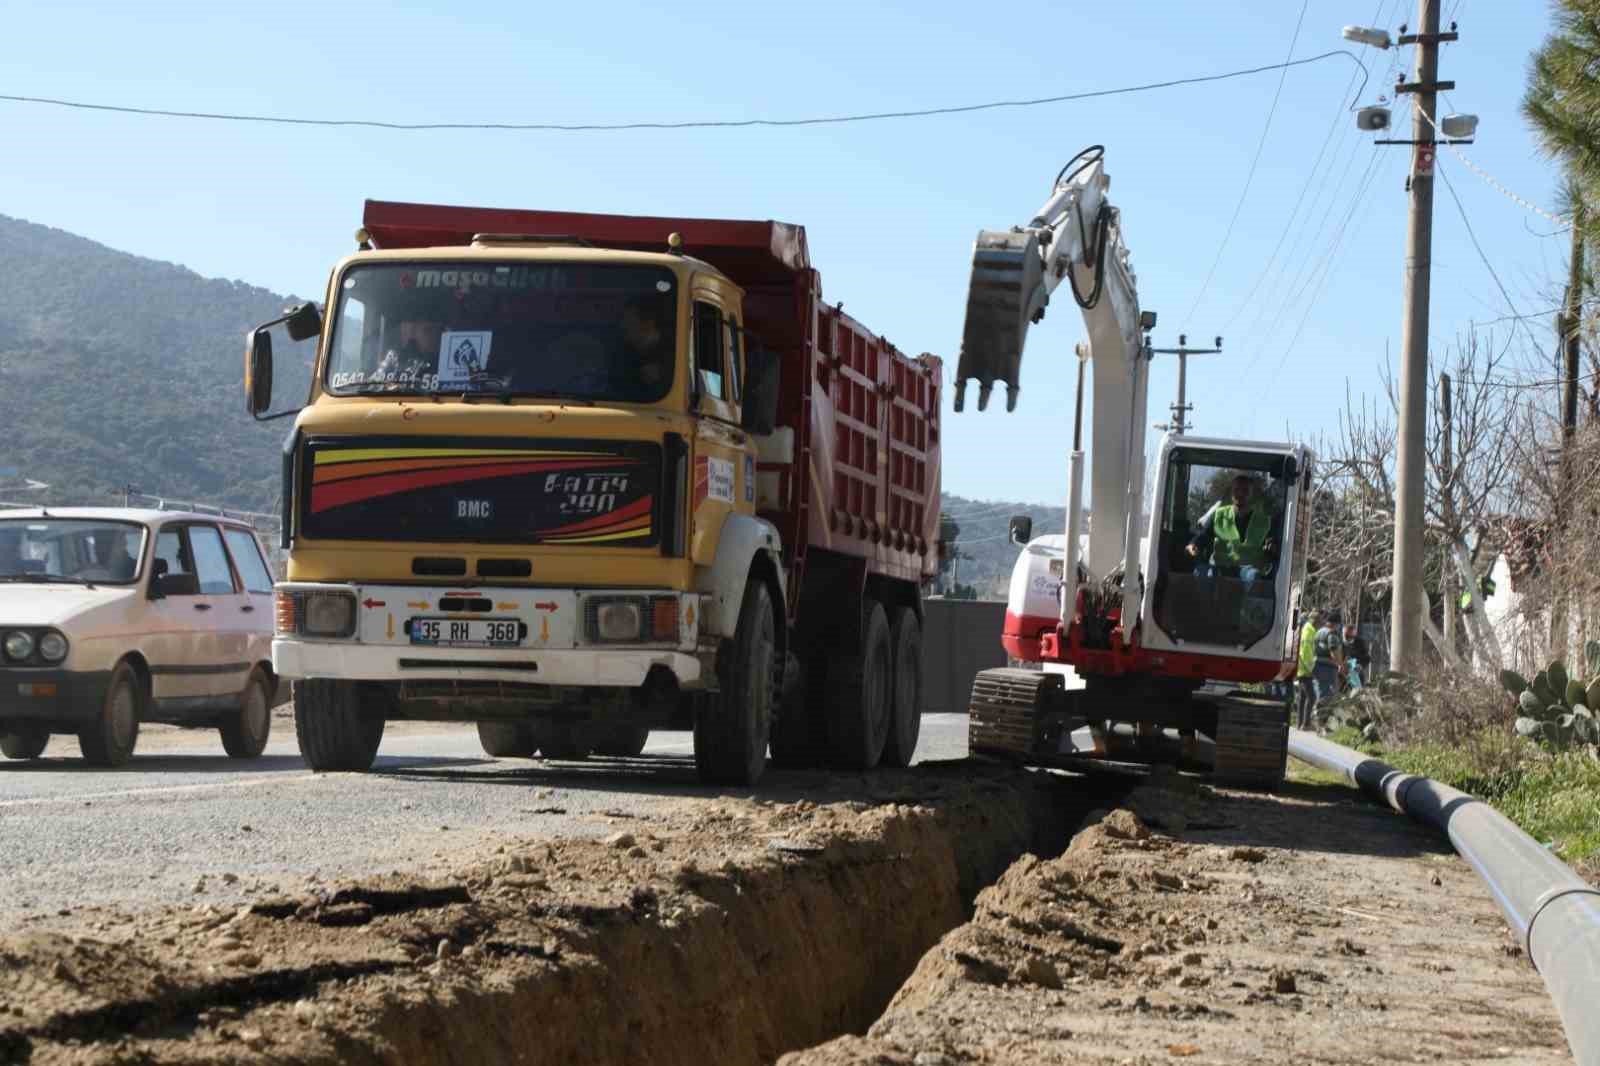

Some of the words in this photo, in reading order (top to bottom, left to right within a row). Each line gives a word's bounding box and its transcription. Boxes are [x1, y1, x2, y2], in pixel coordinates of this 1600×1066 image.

[458, 500, 490, 518] BMC
[423, 621, 440, 640] 35
[450, 622, 469, 641] RH
[486, 622, 515, 641] 368
